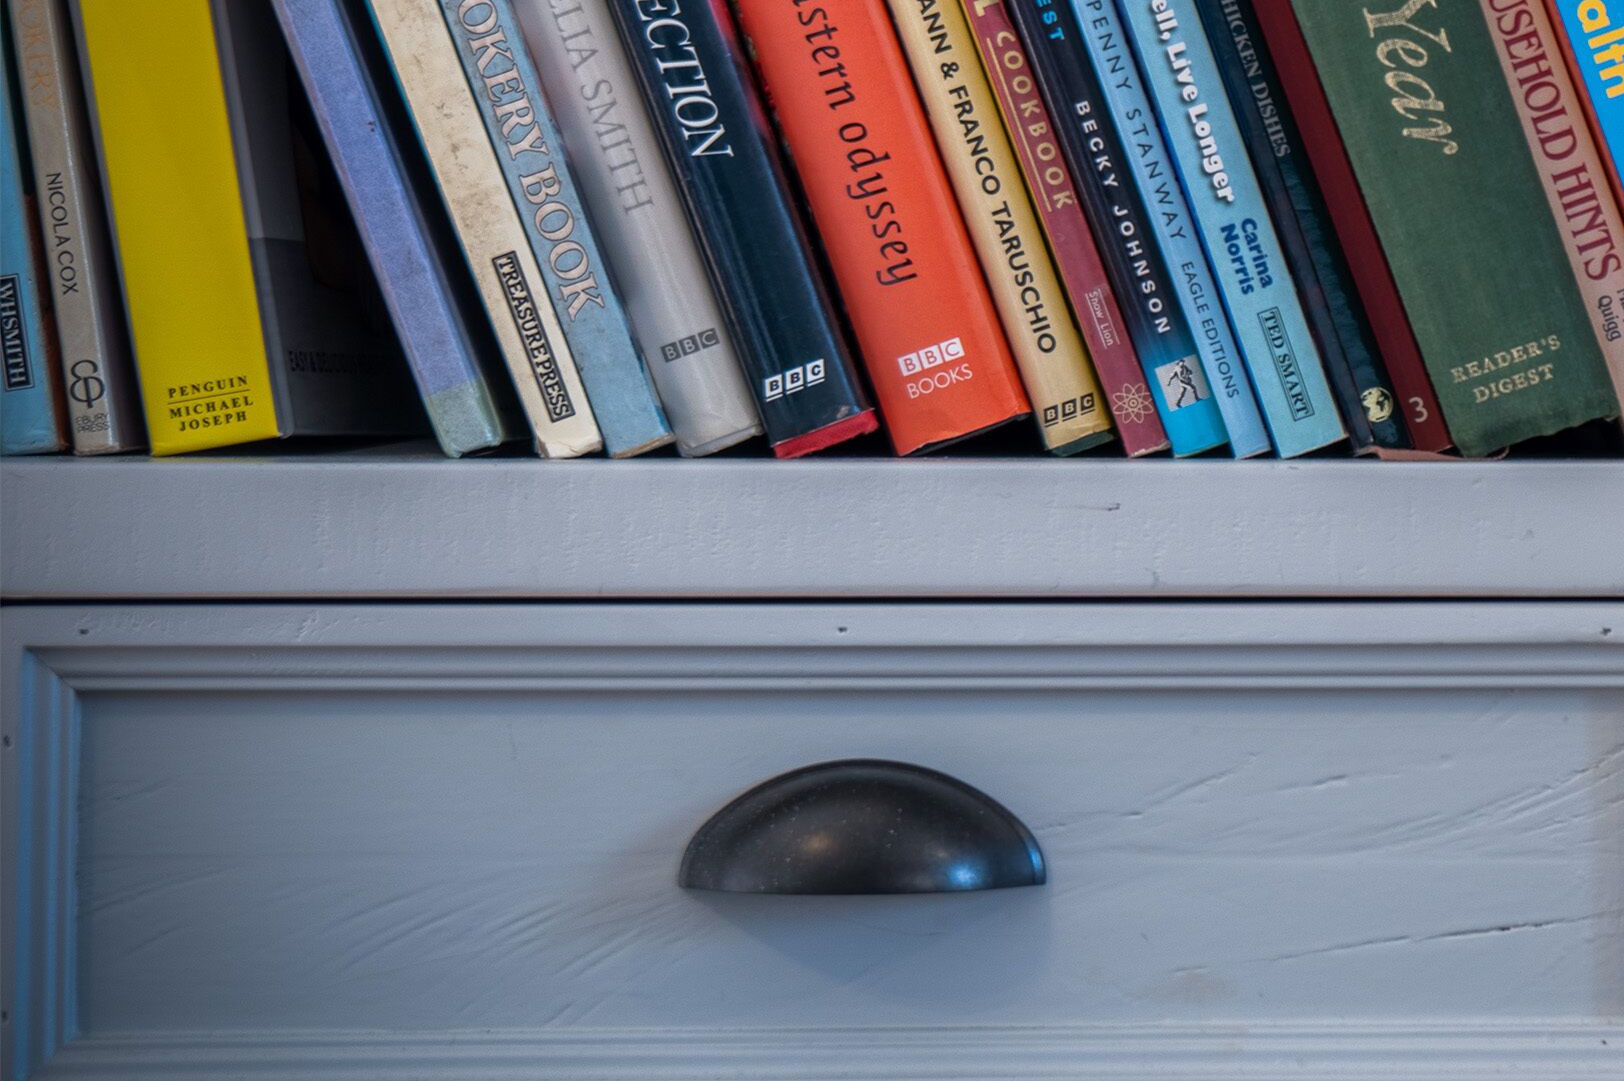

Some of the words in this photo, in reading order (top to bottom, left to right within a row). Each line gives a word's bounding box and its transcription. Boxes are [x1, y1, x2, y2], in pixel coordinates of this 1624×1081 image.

[941, 59, 960, 80] &
[579, 79, 654, 216] SMITH
[949, 85, 1001, 196] FRANCO
[996, 31, 1073, 210] COOKBOOK
[1166, 42, 1198, 104] Live
[1185, 106, 1235, 205] Longer
[1252, 69, 1290, 158] DISHES
[46, 171, 72, 248] NICOLA
[837, 120, 918, 287] odyssey
[1076, 100, 1119, 188] BECKY
[1112, 205, 1171, 335] JOHNSON
[1086, 0, 1133, 91] PENNY
[1125, 107, 1188, 242] STANWAY
[1180, 260, 1208, 314] EAGLE
[1201, 319, 1241, 400] EDITIONS
[1552, 160, 1622, 282] HINTS
[57, 250, 79, 295] COX
[519, 162, 606, 320] BOOK
[1220, 224, 1256, 296] Norris
[1241, 216, 1273, 290] Carina
[990, 200, 1057, 355] TARUSCHIO
[661, 327, 719, 363] BBC
[1088, 291, 1104, 318] Snow
[1101, 322, 1114, 346] Lion
[1598, 295, 1622, 342] Quigg
[168, 376, 248, 399] PENGUIN
[764, 359, 825, 402] BBC
[898, 338, 965, 377] BBC
[906, 363, 973, 399] BOOKS
[1263, 311, 1285, 349] TED
[1278, 353, 1310, 417] SMART
[1471, 363, 1554, 405] DIGEST
[169, 395, 254, 419] MICHAEL
[179, 410, 247, 432] JOSEPH
[1043, 392, 1096, 426] BBC
[1409, 397, 1428, 423] 3
